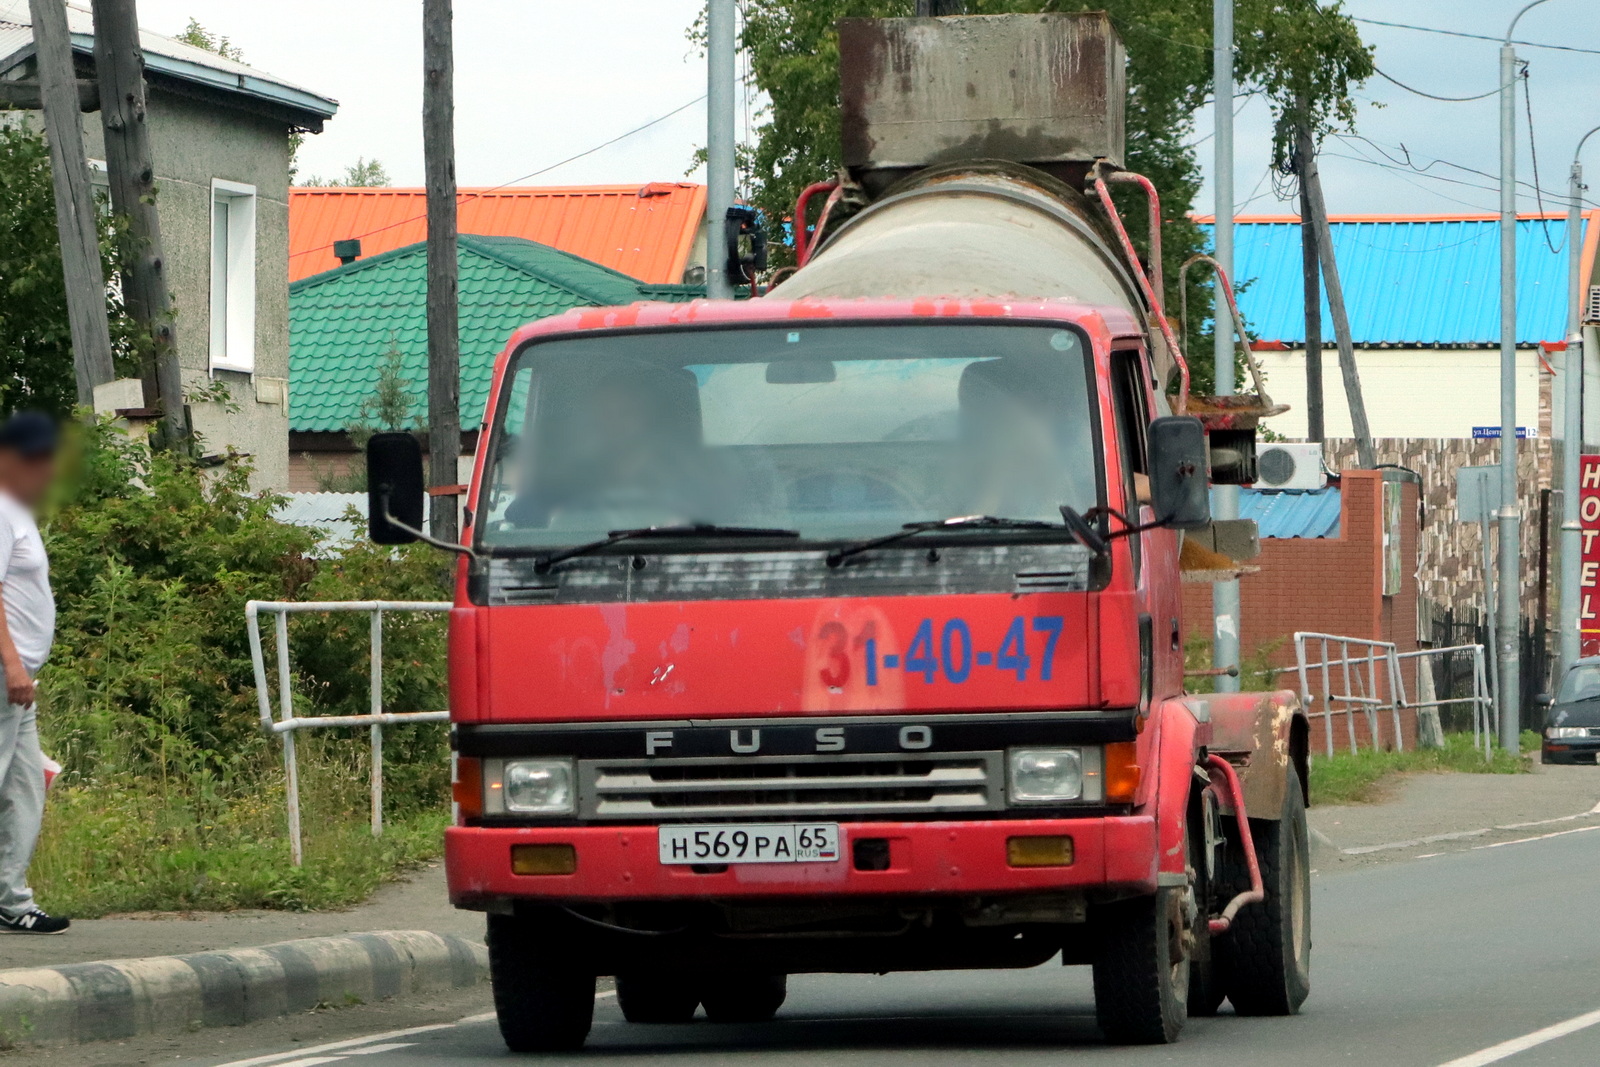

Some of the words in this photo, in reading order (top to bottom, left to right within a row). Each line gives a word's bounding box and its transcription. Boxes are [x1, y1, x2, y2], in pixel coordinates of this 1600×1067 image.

[1580, 463, 1600, 619] HOTEL
[818, 615, 1065, 688] 31-40-47
[646, 725, 933, 755] FUSO
[672, 830, 791, 859] Н569РА
[799, 827, 828, 848] 65
[797, 849, 819, 858] RUS
